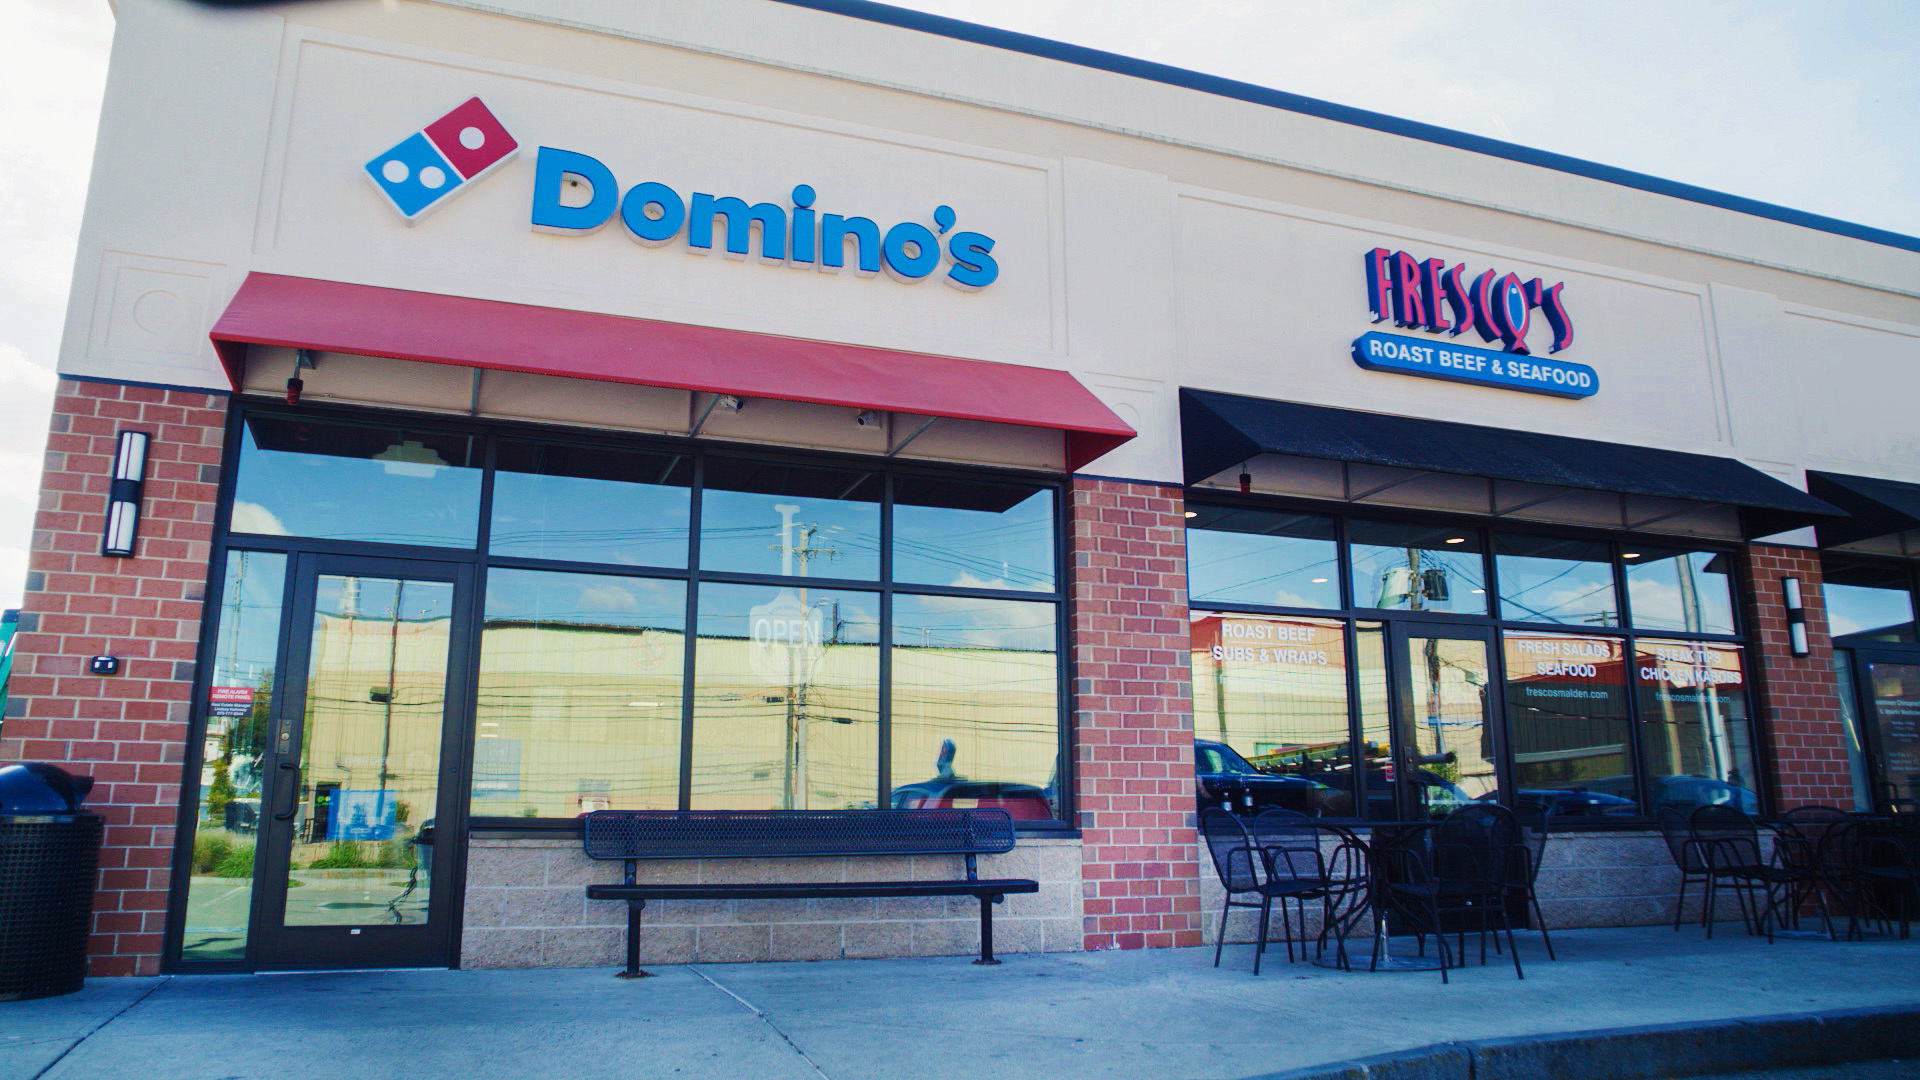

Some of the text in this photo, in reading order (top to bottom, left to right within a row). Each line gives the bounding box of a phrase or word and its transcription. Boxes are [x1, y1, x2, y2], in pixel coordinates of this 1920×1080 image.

[532, 146, 999, 292] Domino's
[1365, 247, 1573, 355] FRESCO'S
[1370, 339, 1591, 388] ROAST BEEF & SEAFOOD
[754, 618, 819, 649] OPEN
[1222, 623, 1316, 642] ROAST BEEF
[1213, 645, 1327, 665] SUBS & WRAPS
[1519, 641, 1611, 658] FRESH SALADS
[1656, 648, 1722, 665] STEAK TIPS
[1536, 662, 1597, 678] SEAFOOD
[1640, 667, 1743, 685] CHICKEN KABOBS
[1525, 686, 1609, 700] frescosmalden.com
